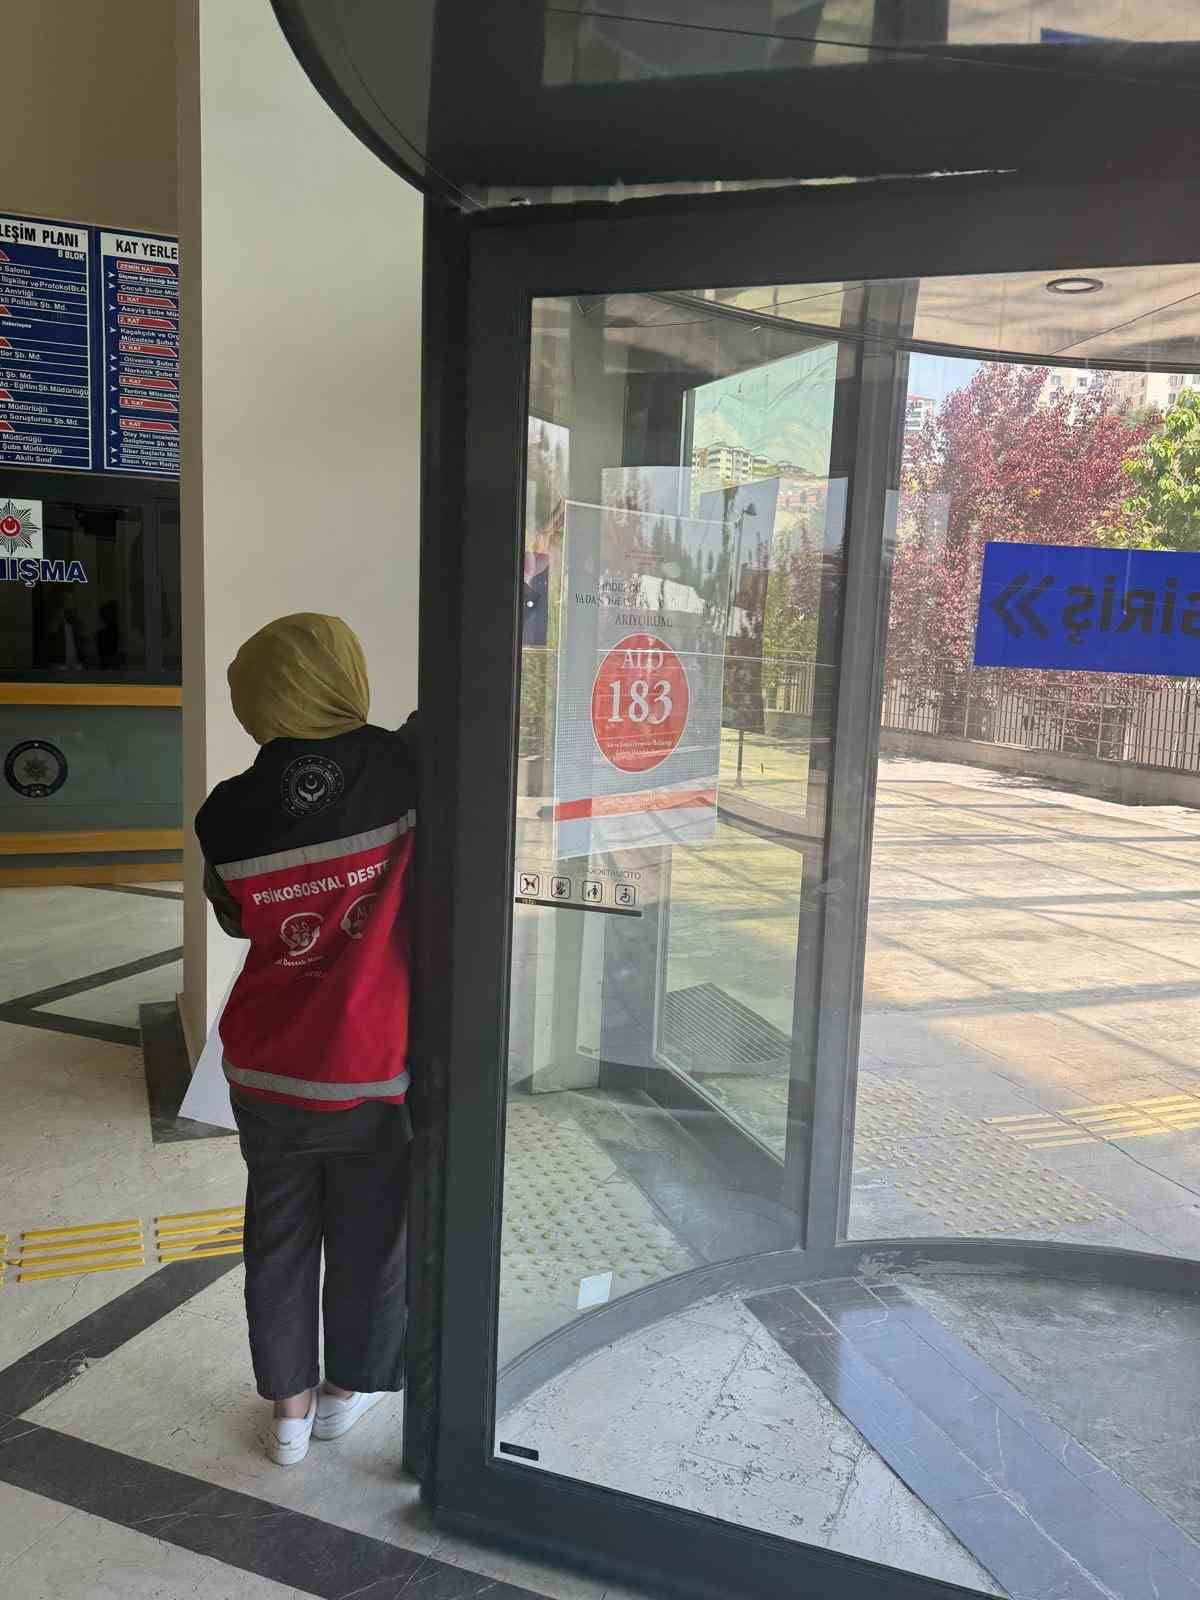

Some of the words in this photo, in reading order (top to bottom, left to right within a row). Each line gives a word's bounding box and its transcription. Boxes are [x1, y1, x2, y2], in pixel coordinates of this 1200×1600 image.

[42, 230, 79, 248] PLANI
[115, 239, 138, 254] KAT
[142, 243, 177, 260] YERLE
[607, 679, 673, 725] 183
[252, 876, 345, 906] PSİKOSOSYAL
